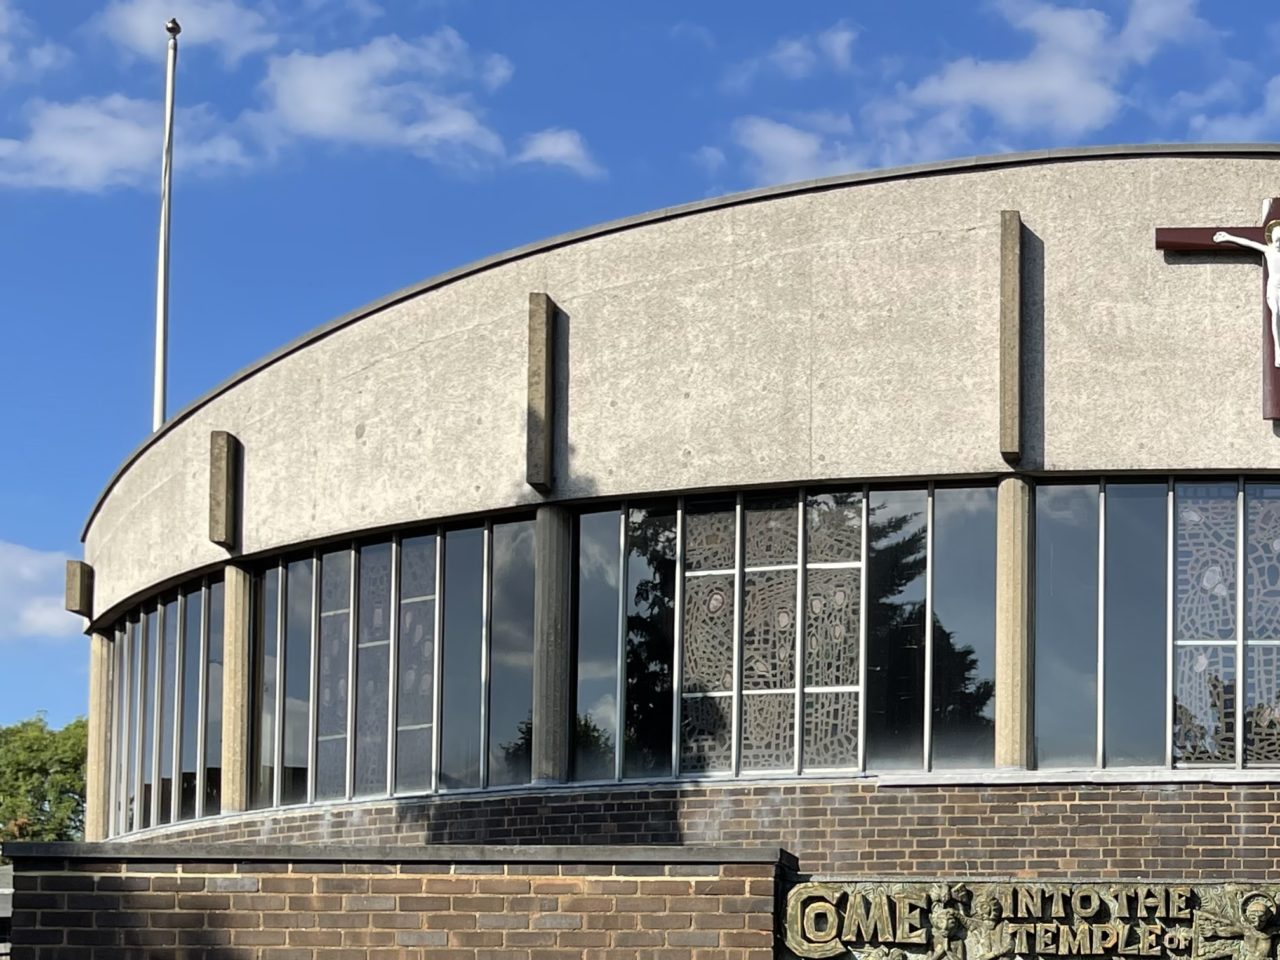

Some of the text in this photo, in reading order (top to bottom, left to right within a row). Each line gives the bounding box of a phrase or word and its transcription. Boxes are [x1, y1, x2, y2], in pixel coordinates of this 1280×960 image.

[999, 886, 1191, 918] INTO THE
[785, 882, 927, 959] COME
[1009, 923, 1191, 955] TEMPLE OF
